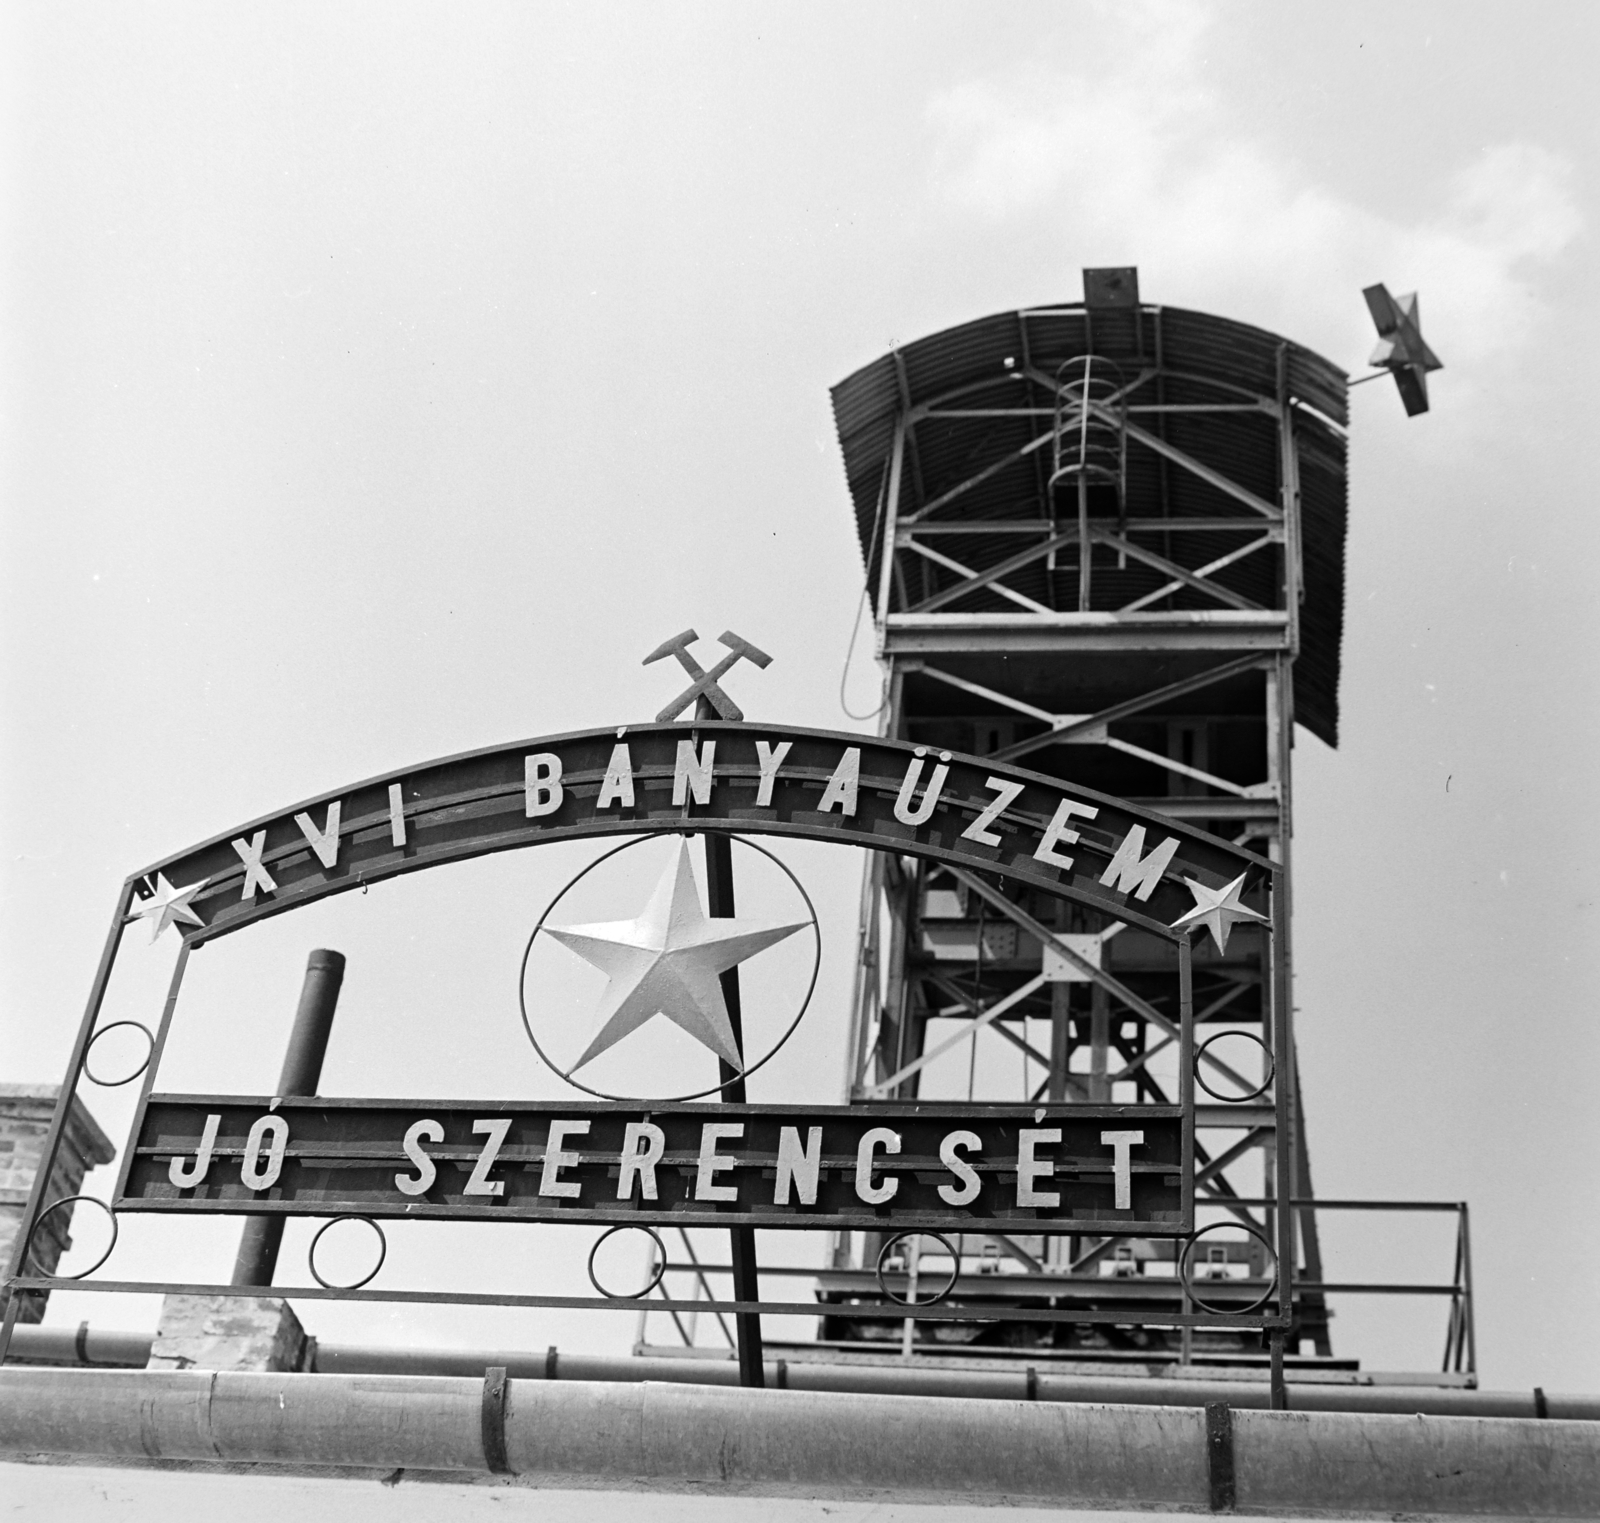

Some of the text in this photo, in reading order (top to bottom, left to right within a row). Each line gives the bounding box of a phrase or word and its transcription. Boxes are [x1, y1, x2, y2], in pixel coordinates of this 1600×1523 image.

[231, 727, 1180, 902] XVI BÁNYAÜZEM
[168, 1098, 1144, 1210] JÓ SZERENCSÉT
